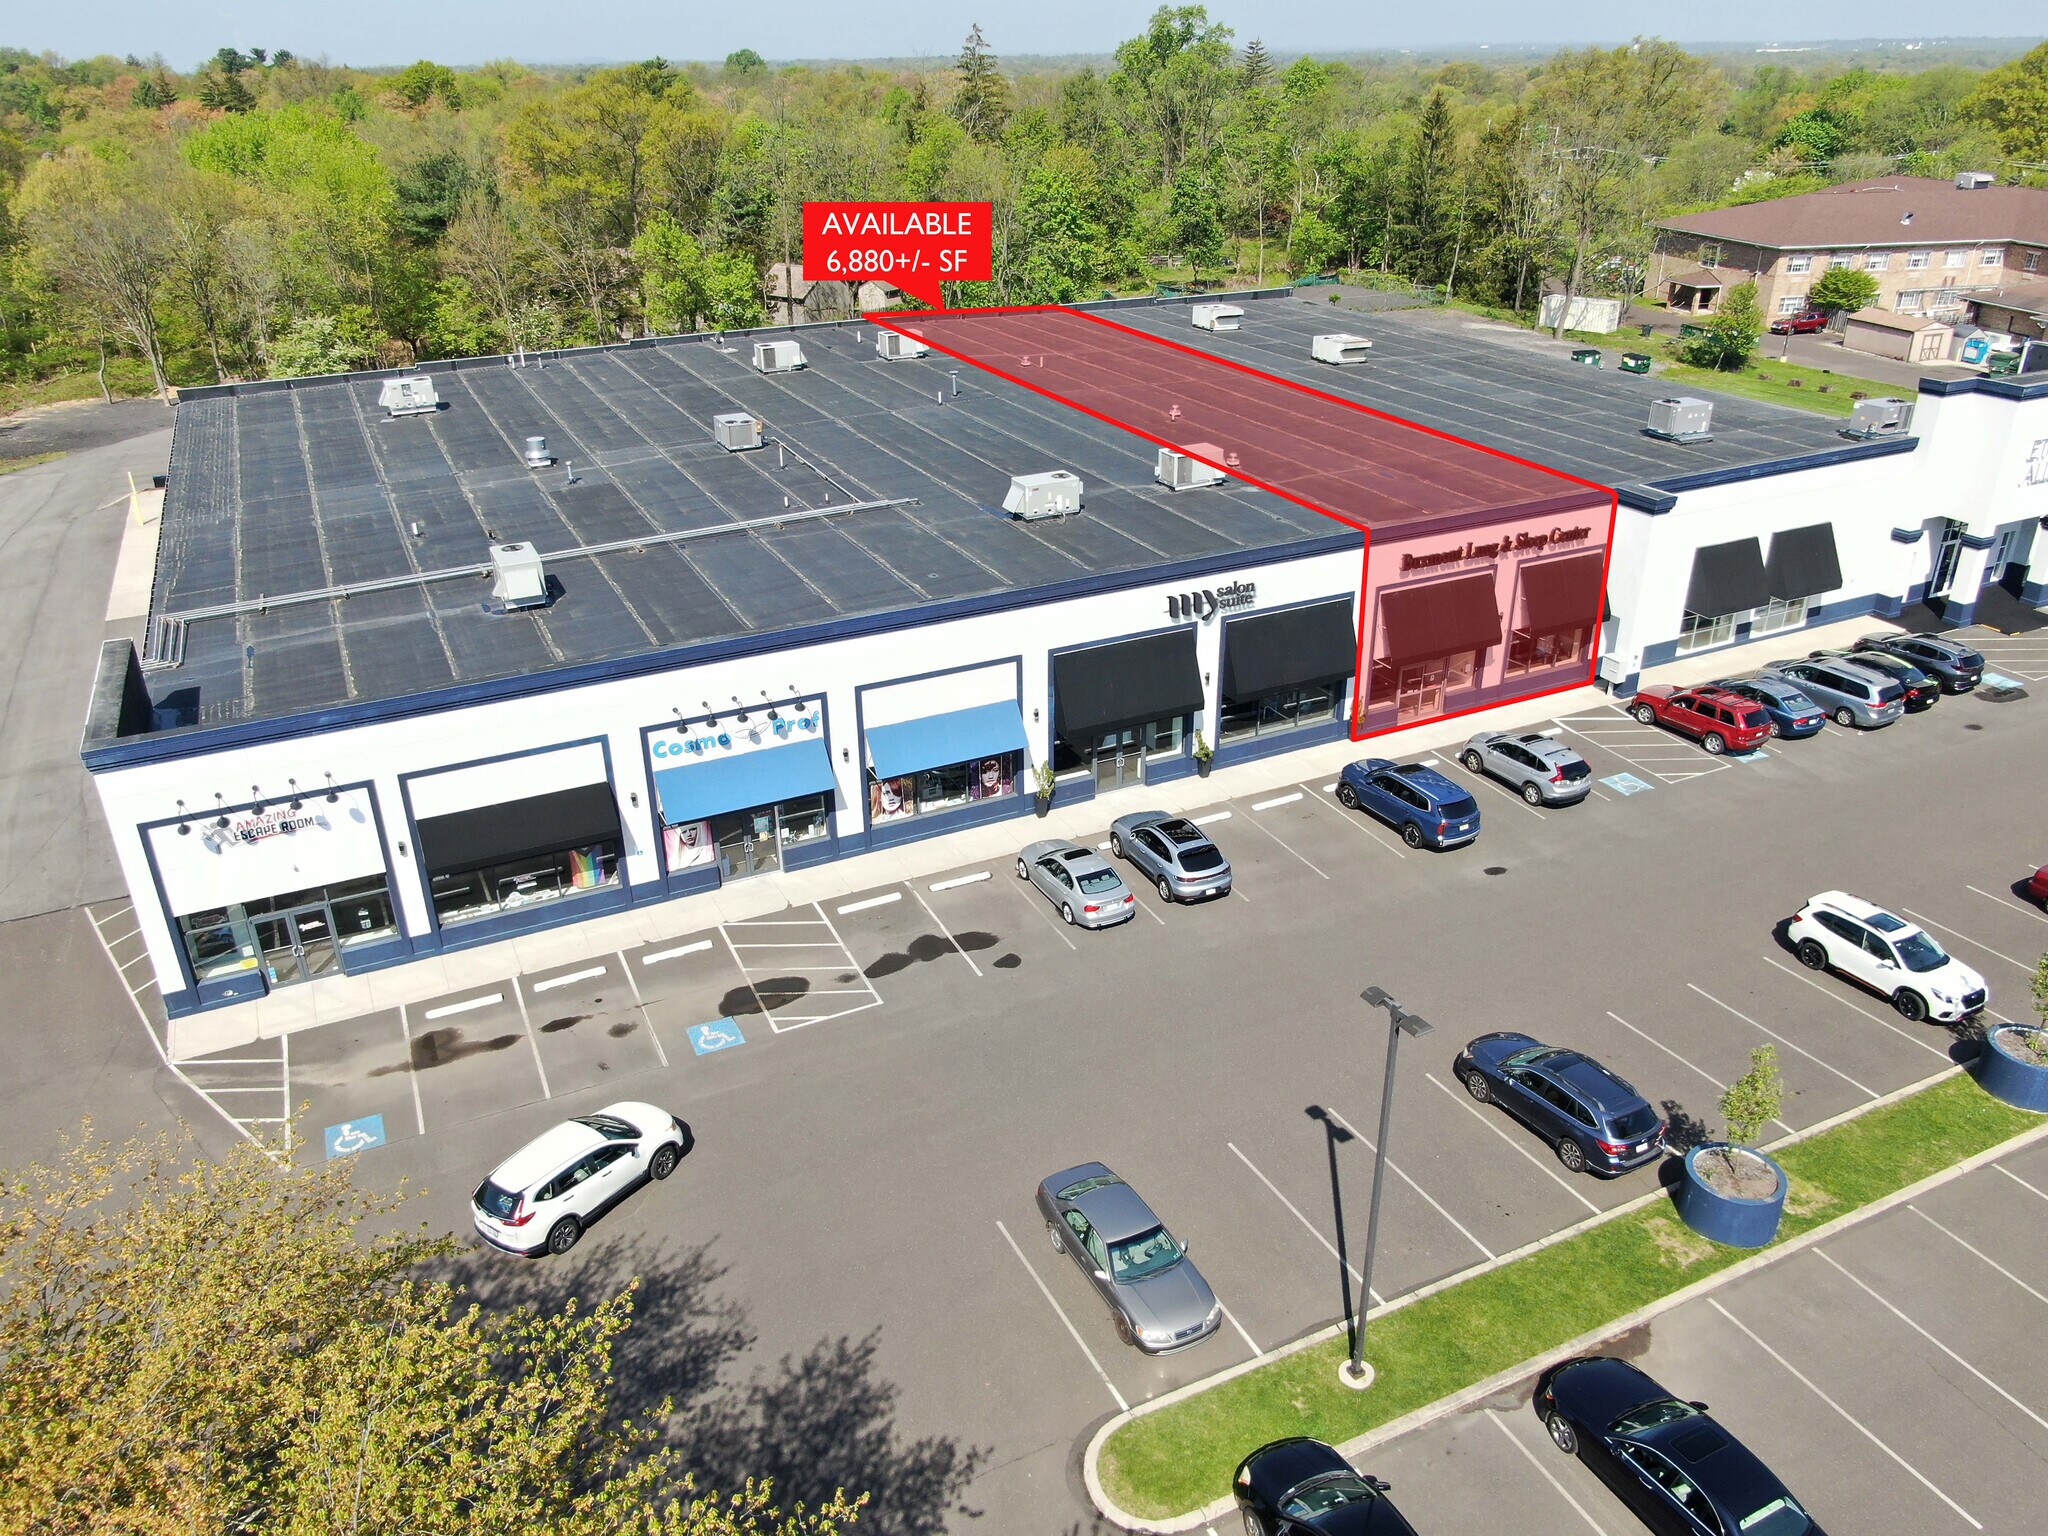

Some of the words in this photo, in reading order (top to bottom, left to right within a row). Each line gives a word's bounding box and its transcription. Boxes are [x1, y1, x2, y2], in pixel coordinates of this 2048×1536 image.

[1463, 542, 1500, 559] Lung
[1500, 535, 1512, 553] &
[1512, 531, 1549, 551] Sleep
[1549, 526, 1591, 545] Center
[1216, 580, 1256, 597] salon
[1219, 594, 1254, 609] suite
[1166, 589, 1219, 621] my
[652, 732, 732, 758] Cosmo
[772, 710, 820, 736] Prof
[233, 824, 279, 842] ESCAPE
[280, 816, 315, 832] ROOM
[236, 809, 298, 832] AMAZING
